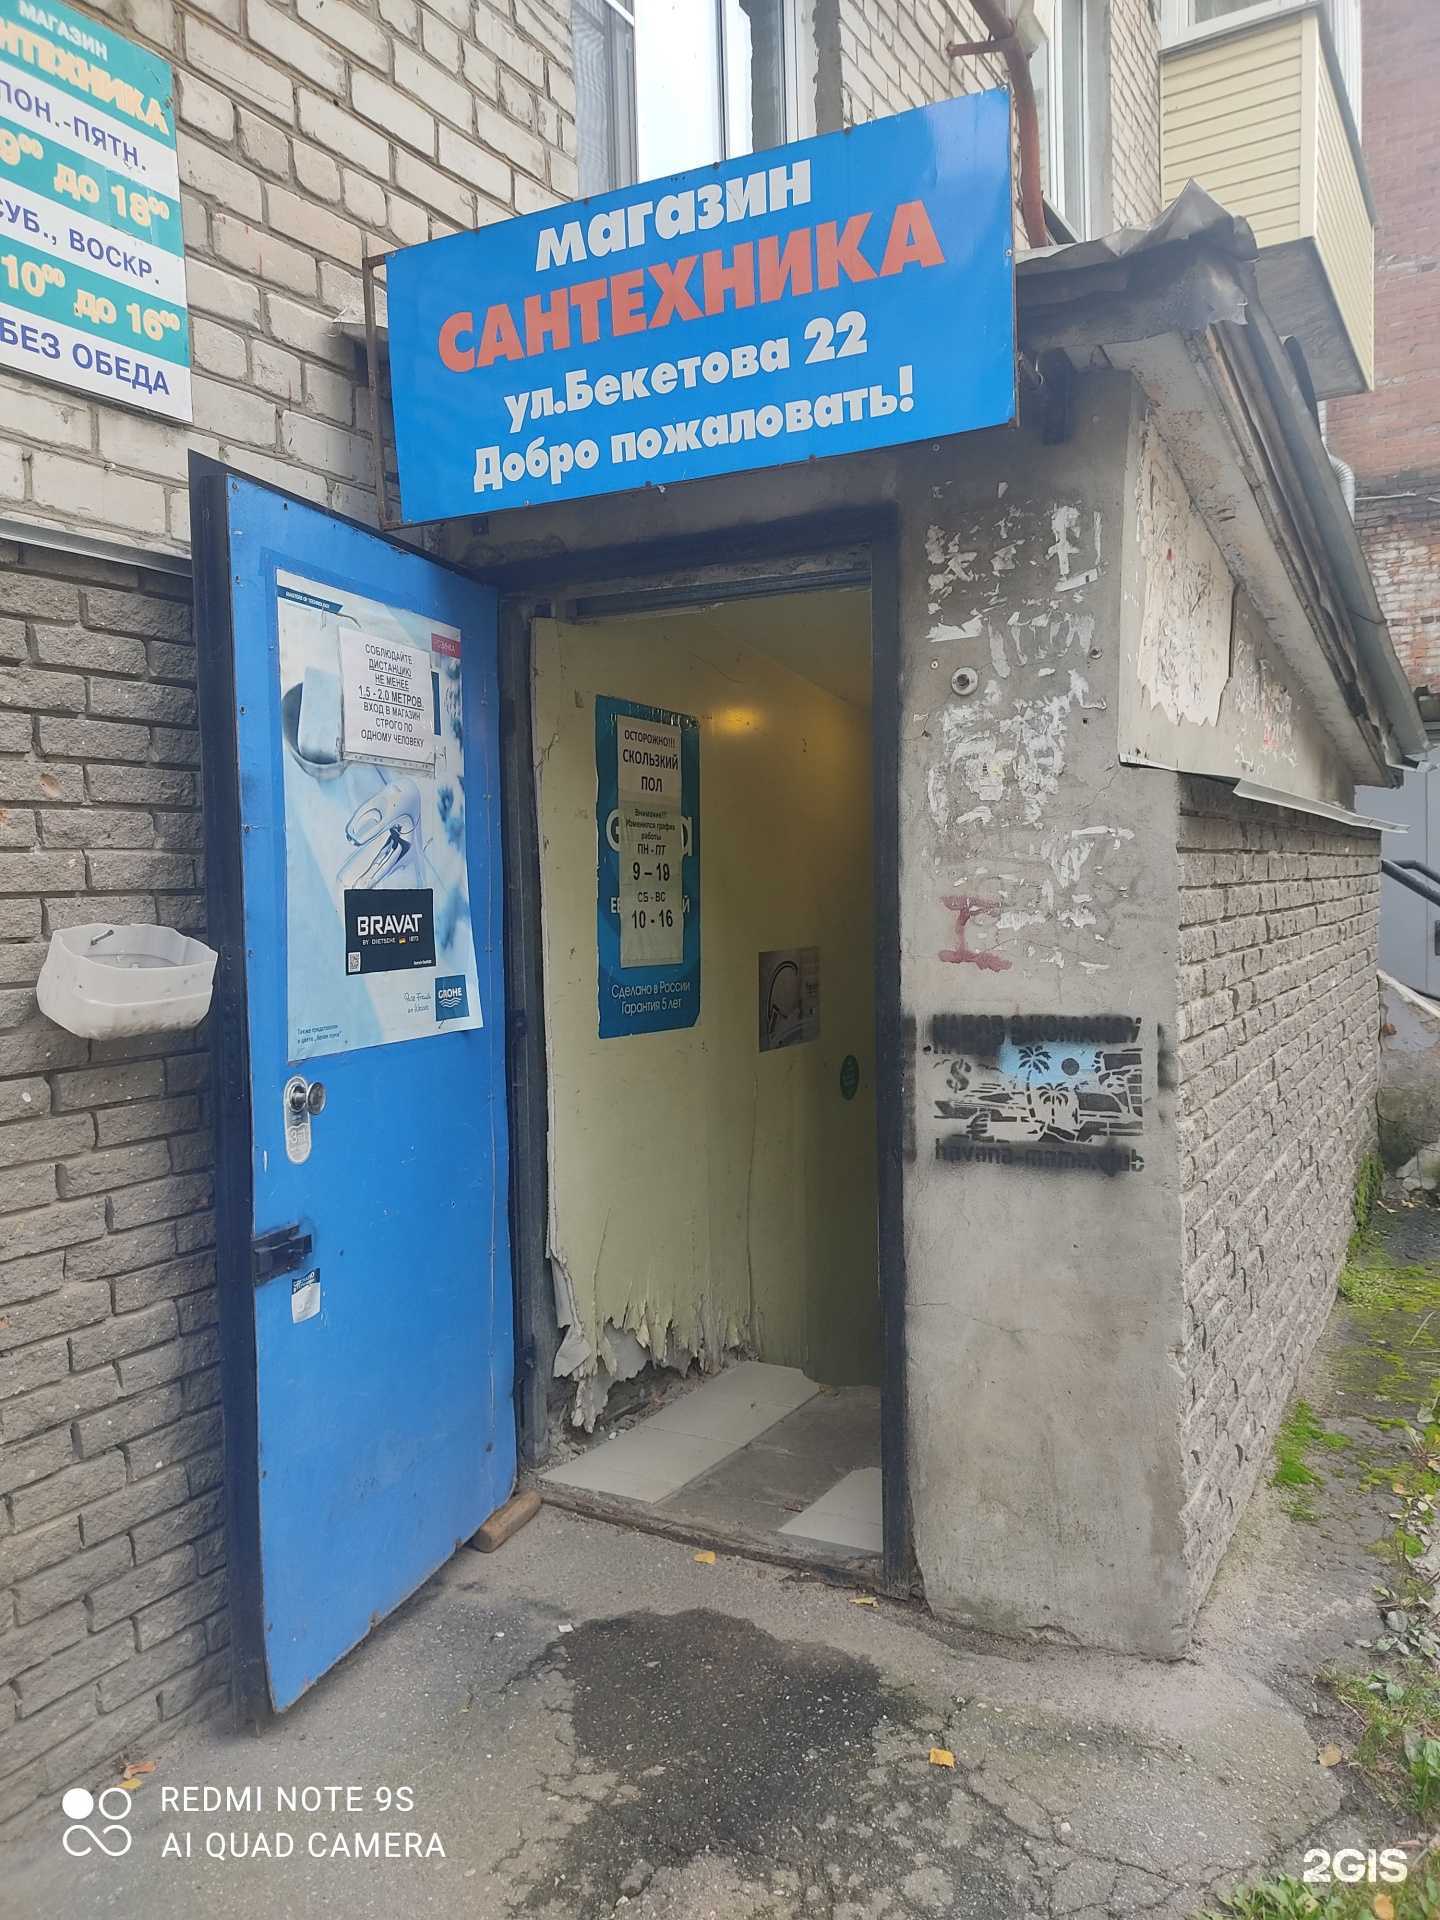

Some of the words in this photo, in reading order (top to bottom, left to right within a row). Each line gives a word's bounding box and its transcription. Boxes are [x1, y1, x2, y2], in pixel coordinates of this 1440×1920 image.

[19, 0, 108, 62] МАГАЗИН
[54, 163, 100, 203] до
[535, 160, 812, 272] магазин
[0, 199, 56, 245] УБ.,
[69, 228, 159, 284] ВОСКР.
[439, 200, 945, 373] САНТЕХНИКА
[73, 289, 117, 324] до
[0, 316, 60, 359] БЕЗ
[72, 343, 170, 395] ОБЕДА
[505, 337, 790, 434] ул.Бекетова
[804, 311, 868, 364] 22
[474, 439, 600, 493] Добро
[611, 366, 915, 465] пожаловать!
[365, 644, 412, 664] СОБЛЮДАЙТЕ
[369, 658, 412, 678] ДИСТАНЦИЮ
[376, 675, 384, 684] НЕ
[386, 676, 409, 690] МЕНЕЕ
[364, 702, 384, 716] ВХОД
[386, 705, 390, 714] В
[392, 707, 420, 720] МАГАЗИН
[376, 718, 402, 731] СТРОГО
[404, 723, 413, 733] ПО
[361, 729, 392, 742] ОДНОМУ
[393, 734, 424, 748] ЧЕЛОВЕКУ
[623, 749, 678, 770] СКОЛЬЗКИЙ
[641, 776, 663, 793] ПОЛ
[638, 844, 648, 854] ПН
[656, 845, 667, 856] ПТ
[633, 861, 640, 880] 9
[638, 892, 648, 902] СБ
[655, 892, 666, 902] ВС
[357, 914, 422, 936] BRAVAT
[632, 910, 646, 928] 10
[659, 909, 673, 927] 16
[611, 984, 653, 999] Сделано
[653, 985, 658, 994] в
[659, 981, 691, 994] России
[621, 1000, 660, 1016] Гарантия
[661, 997, 667, 1010] 5
[668, 998, 683, 1010] лет
